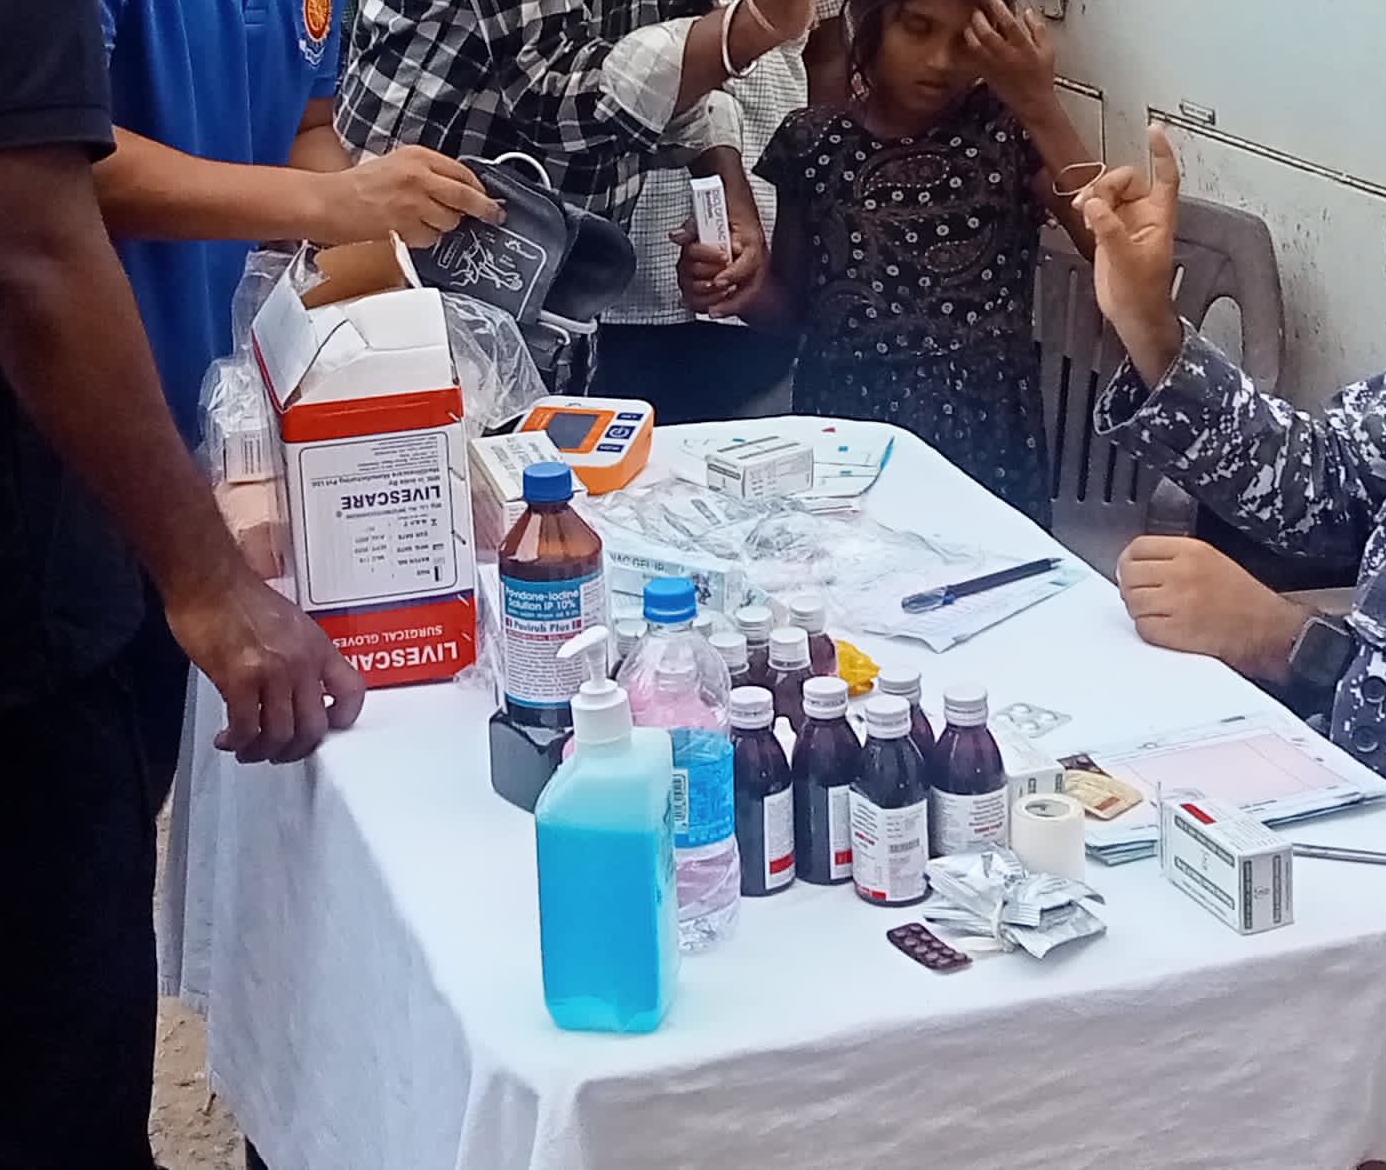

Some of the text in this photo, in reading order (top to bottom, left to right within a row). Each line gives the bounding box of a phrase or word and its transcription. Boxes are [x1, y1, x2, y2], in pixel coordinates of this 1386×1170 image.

[340, 485, 441, 510] LIVESCARE
[332, 624, 443, 648] SURGICAL GLOVES
[343, 641, 458, 671] LIVESCAR
